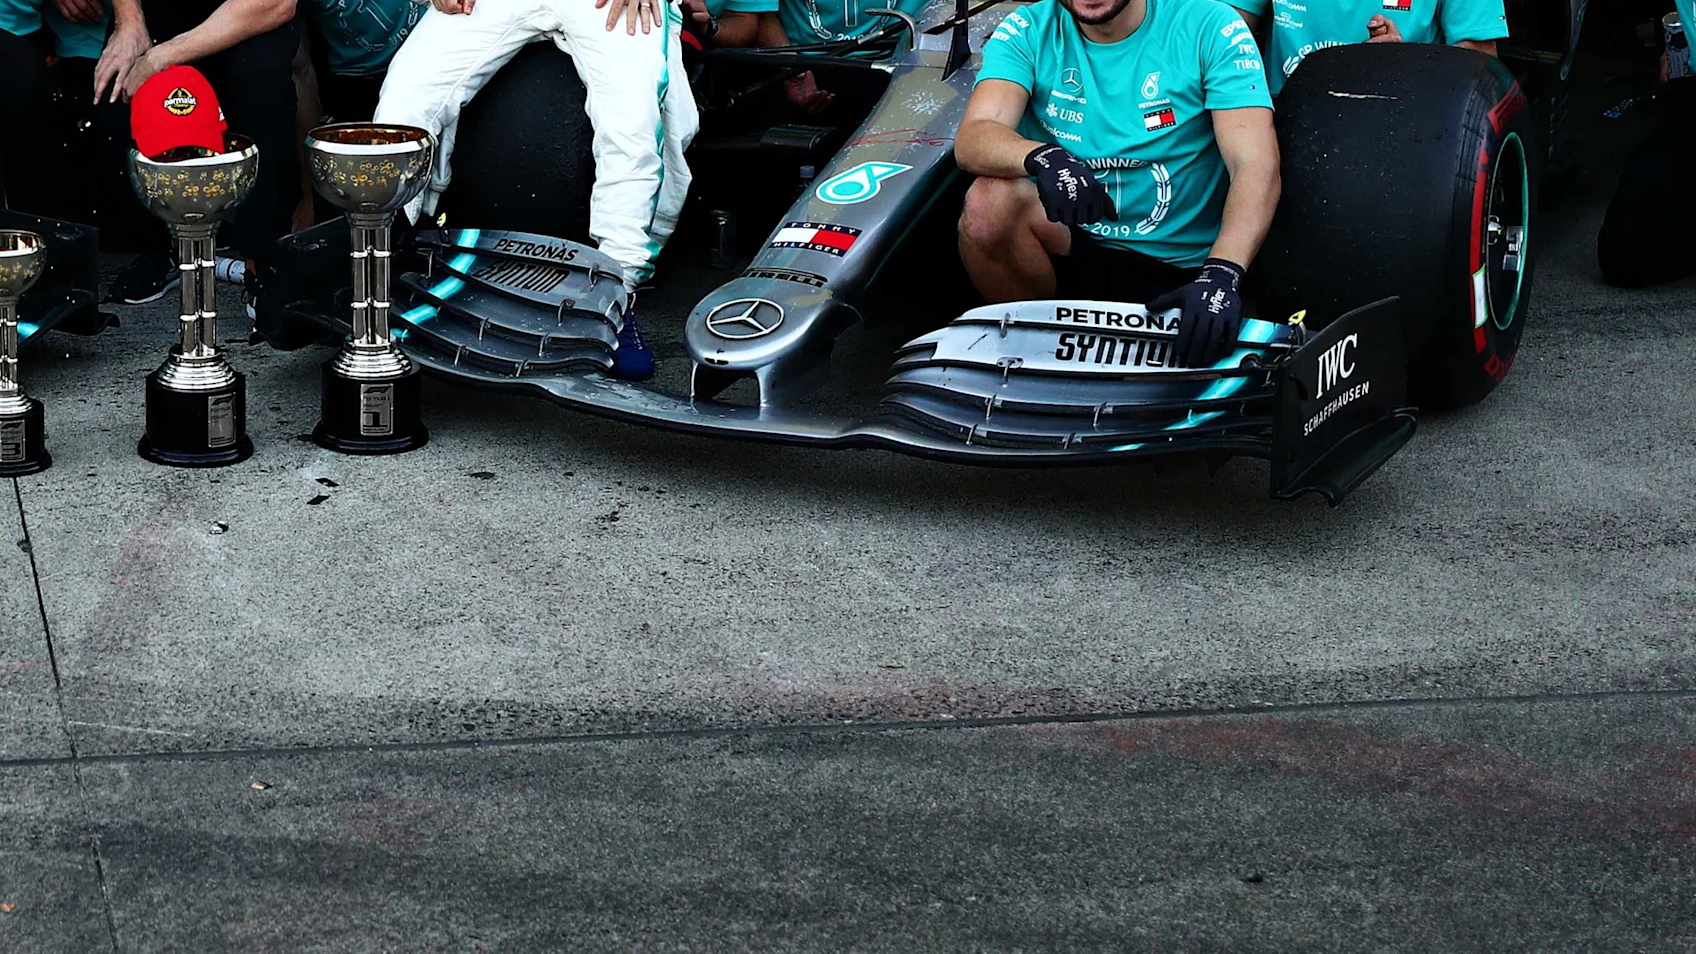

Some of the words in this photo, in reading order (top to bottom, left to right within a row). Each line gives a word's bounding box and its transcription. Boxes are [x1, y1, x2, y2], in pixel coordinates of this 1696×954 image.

[1233, 59, 1261, 71] TIBCO
[164, 96, 198, 108] parmalat
[1138, 97, 1171, 109] PETRONAS
[1059, 107, 1085, 125] UBS
[1039, 118, 1081, 143] Qualcomm
[790, 221, 857, 235] TOMMY
[1090, 222, 1131, 238] 2019
[493, 238, 579, 262] PETRONAS
[773, 241, 840, 256] HILFIGER
[1055, 306, 1182, 332] PETRONA
[1315, 332, 1359, 400] IWC
[1303, 380, 1371, 437] SCHAFFHAUSEN
